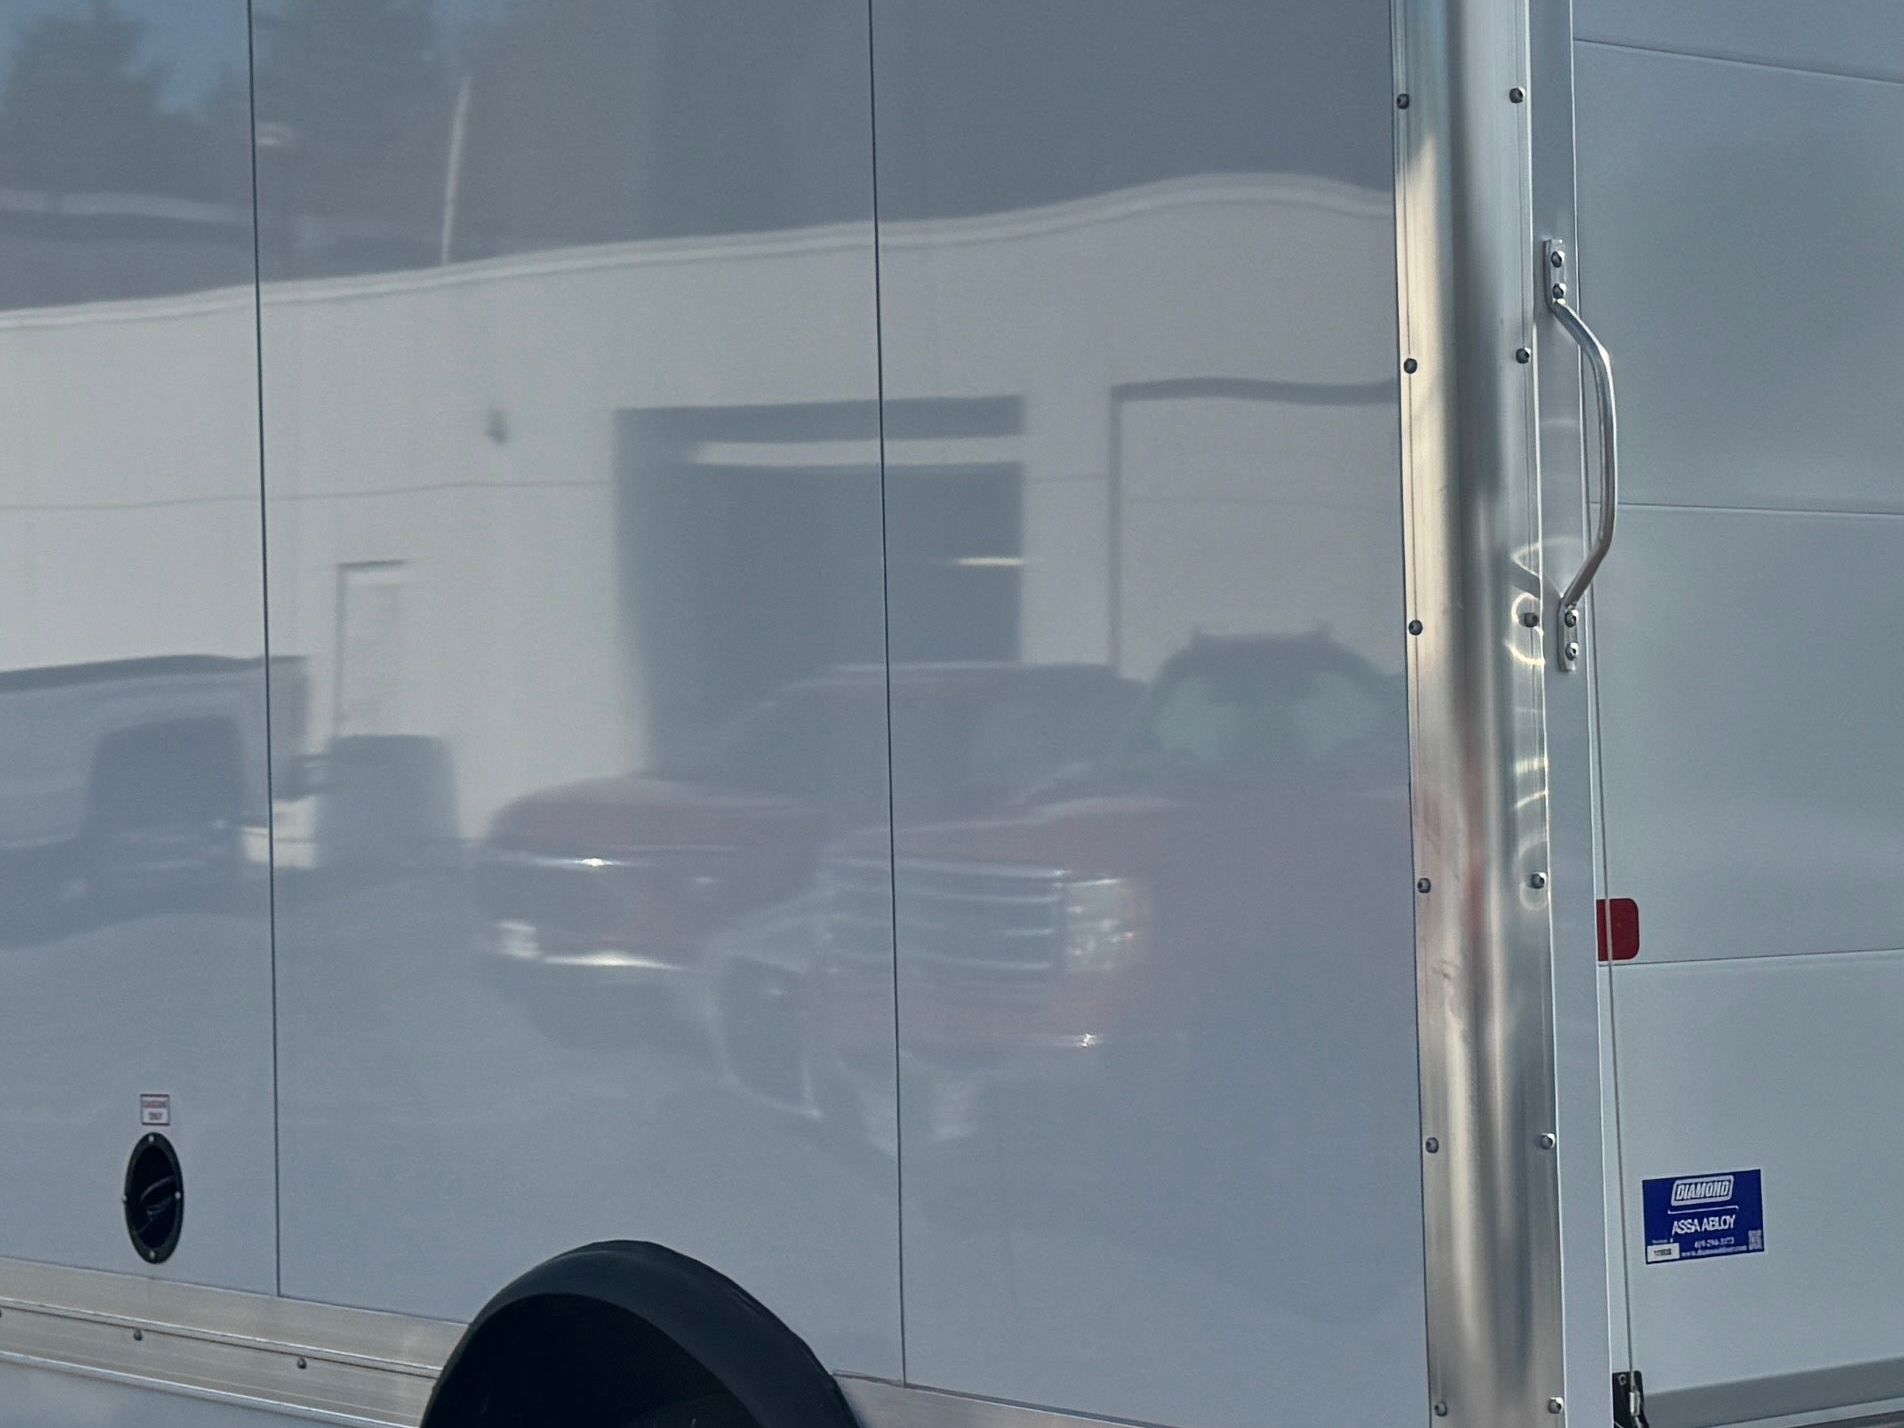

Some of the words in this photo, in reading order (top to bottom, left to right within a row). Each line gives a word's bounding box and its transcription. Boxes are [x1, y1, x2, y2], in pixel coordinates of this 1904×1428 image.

[1675, 1181, 1730, 1201] DIAMOND
[1672, 1218, 1700, 1235] ASSA
[1702, 1215, 1736, 1232] ABLOY
